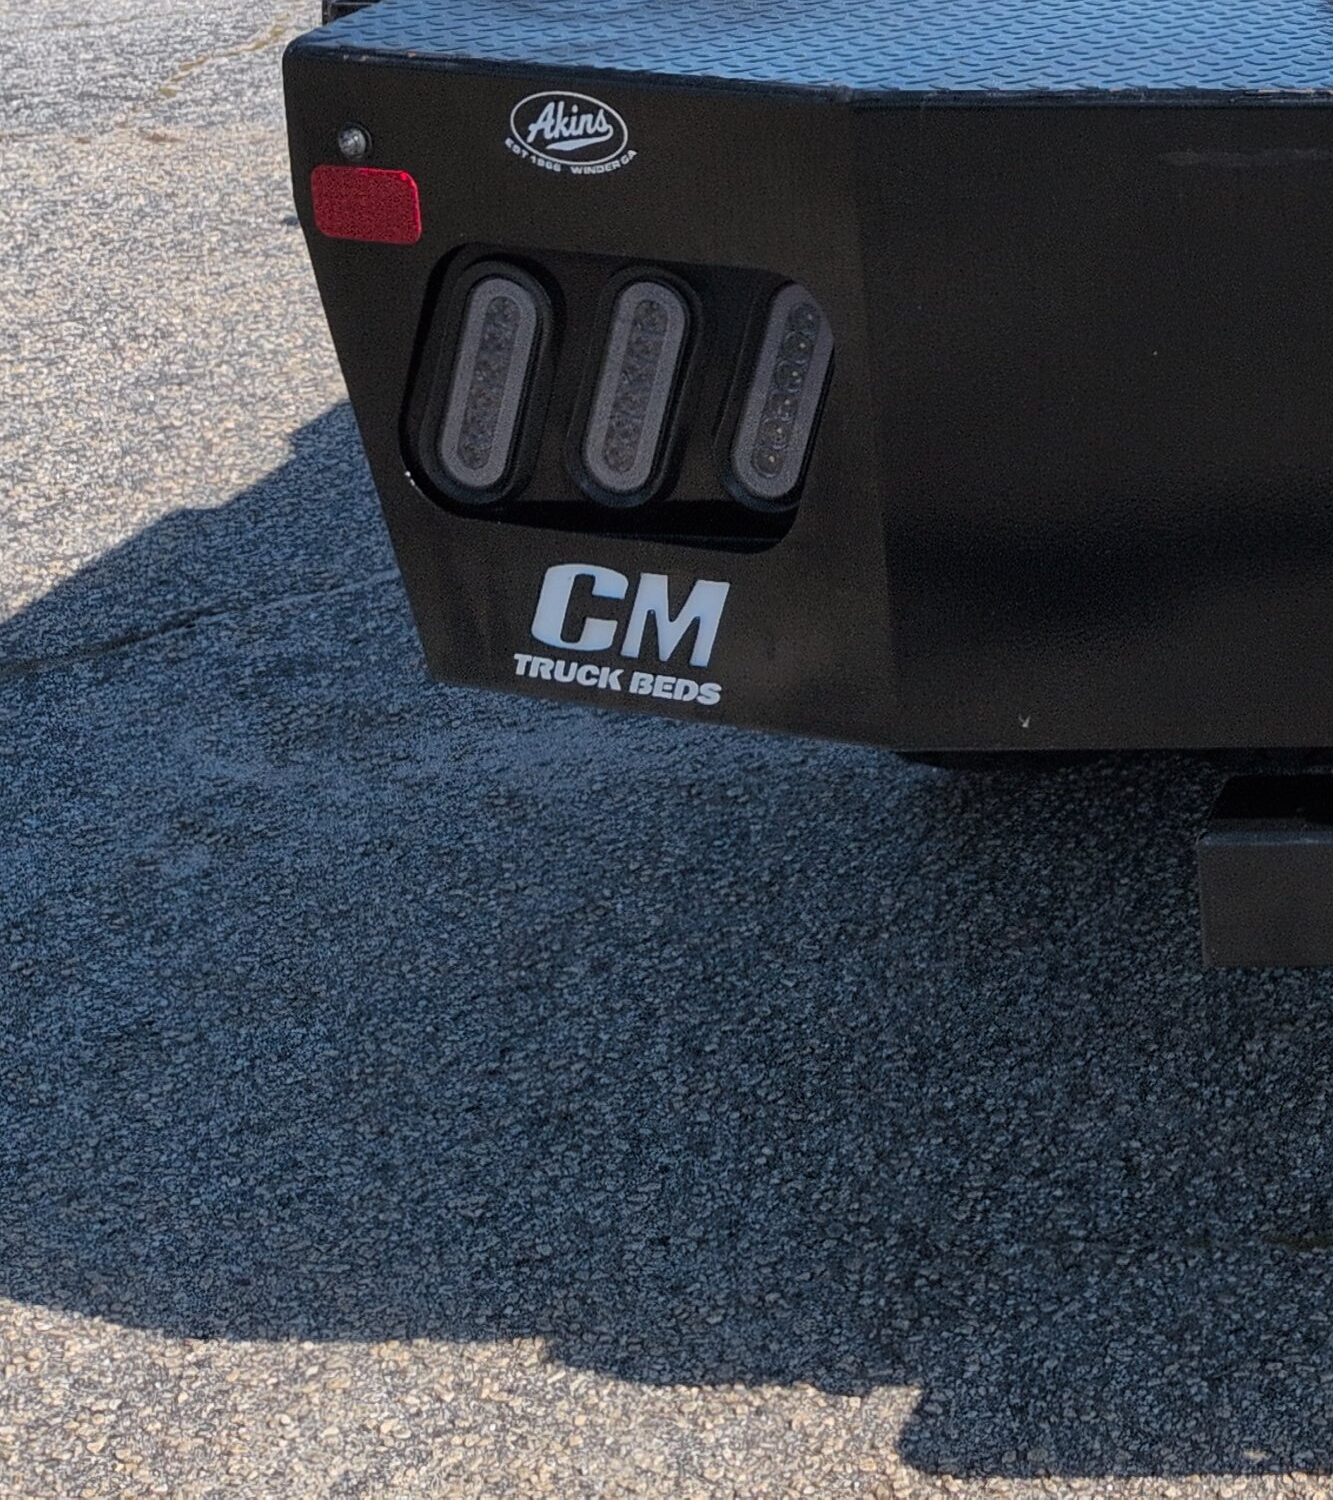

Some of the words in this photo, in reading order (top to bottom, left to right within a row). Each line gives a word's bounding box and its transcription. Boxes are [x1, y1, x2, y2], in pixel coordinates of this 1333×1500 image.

[526, 100, 614, 143] Akins
[569, 159, 621, 175] WINDER
[620, 149, 637, 165] GA
[530, 563, 731, 668] CM
[513, 653, 625, 691] TRUCK
[628, 671, 723, 706] BEDS
